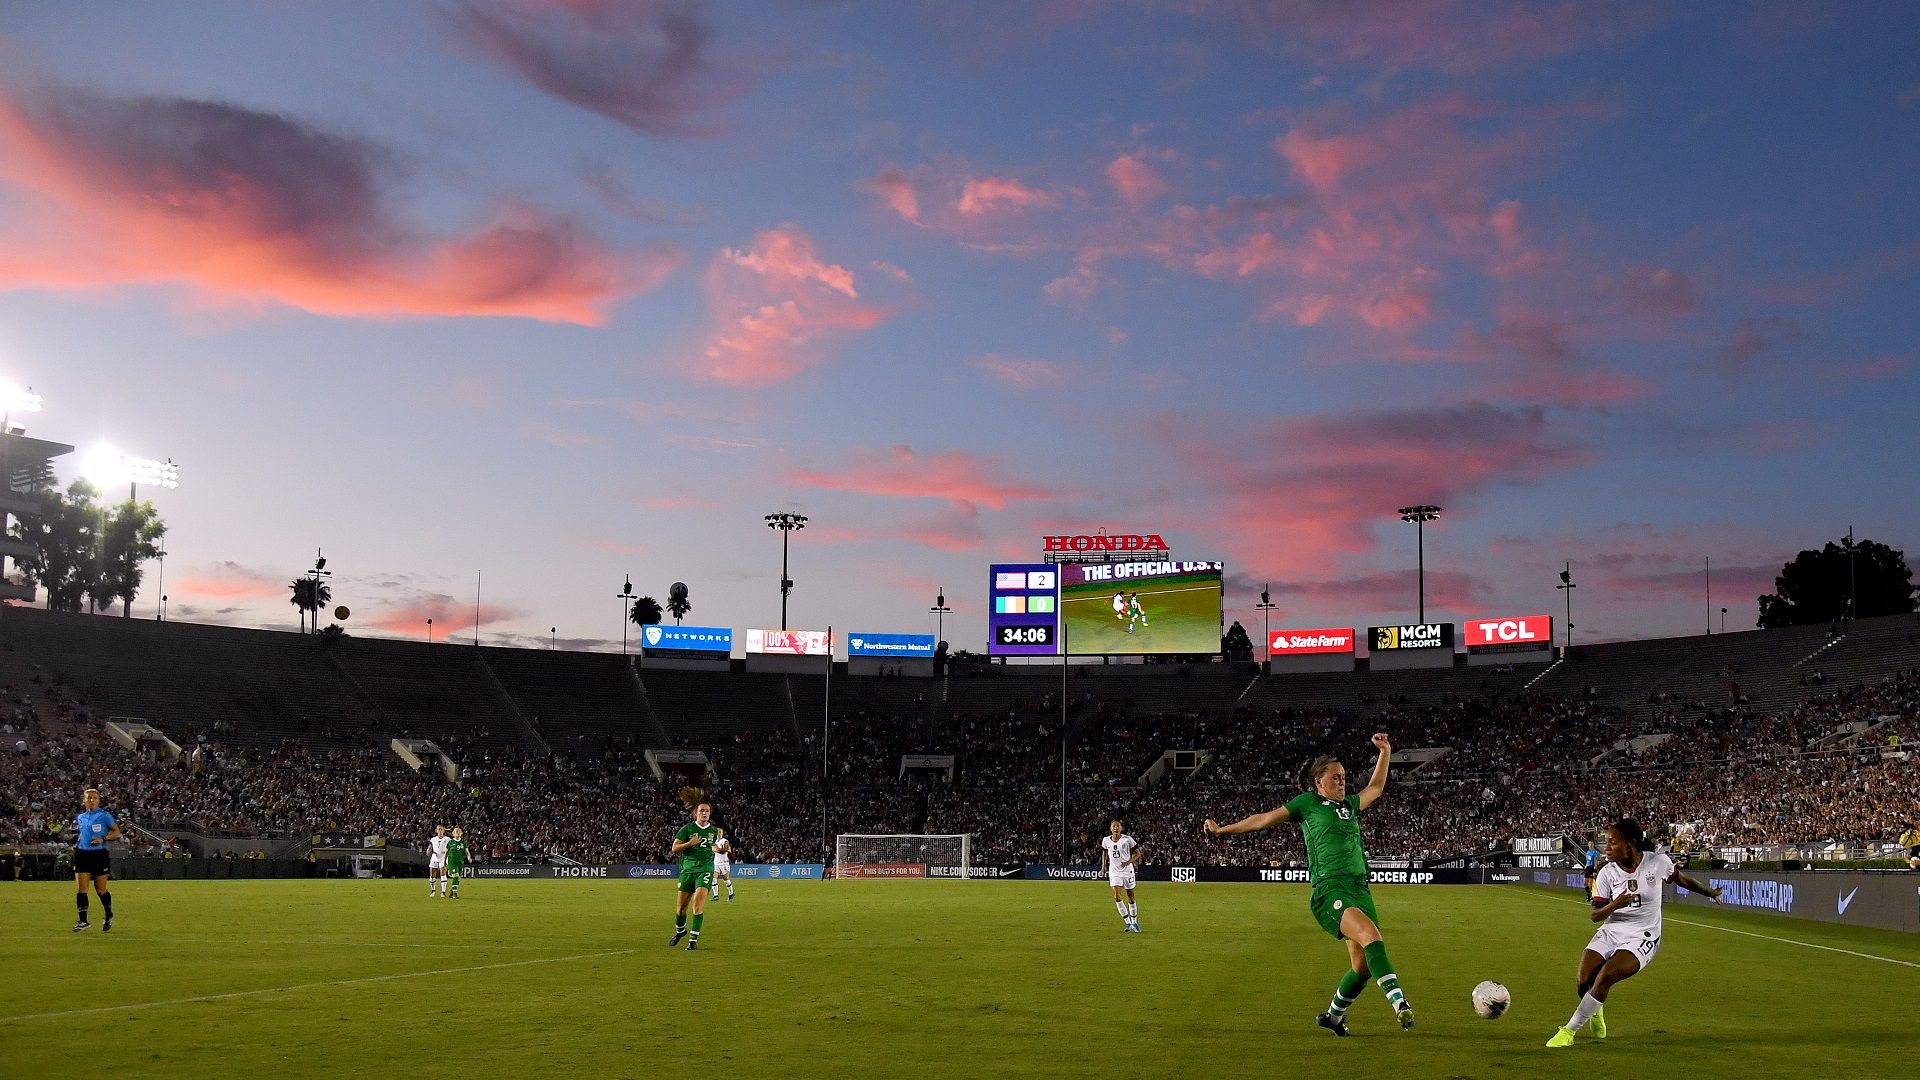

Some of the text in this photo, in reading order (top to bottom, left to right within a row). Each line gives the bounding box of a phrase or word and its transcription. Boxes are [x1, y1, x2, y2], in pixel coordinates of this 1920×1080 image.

[1043, 534, 1170, 551] HONDA
[1082, 564, 1112, 581] THE
[1114, 561, 1180, 579] OFFICIAL
[1038, 575, 1046, 586] 2
[1036, 598, 1046, 611] 0
[1003, 628, 1047, 643] 34:06
[1400, 625, 1441, 639] MGM
[1479, 621, 1535, 641] TCL
[665, 633, 730, 642] NETWORKS
[764, 631, 790, 647] 100%
[1400, 639, 1441, 648] RESORTS
[700, 838, 708, 848] 2
[1515, 837, 1553, 851] ONE NATION.
[1112, 850, 1121, 858] 23
[1518, 856, 1532, 868] ONE
[1532, 856, 1551, 868] TEAM.
[553, 866, 607, 877] THORNE
[643, 868, 671, 876] Allstate
[738, 867, 758, 876] AT&T
[791, 867, 812, 876] AT&T
[864, 868, 877, 876] THIS
[896, 868, 908, 876] FOR
[909, 868, 922, 876] YOU.
[1172, 868, 1195, 882] USA
[1260, 870, 1282, 881] THE
[703, 872, 711, 884] 2
[1409, 872, 1434, 883] APP
[1752, 880, 1778, 909] SOCCER
[1778, 884, 1794, 913] APP
